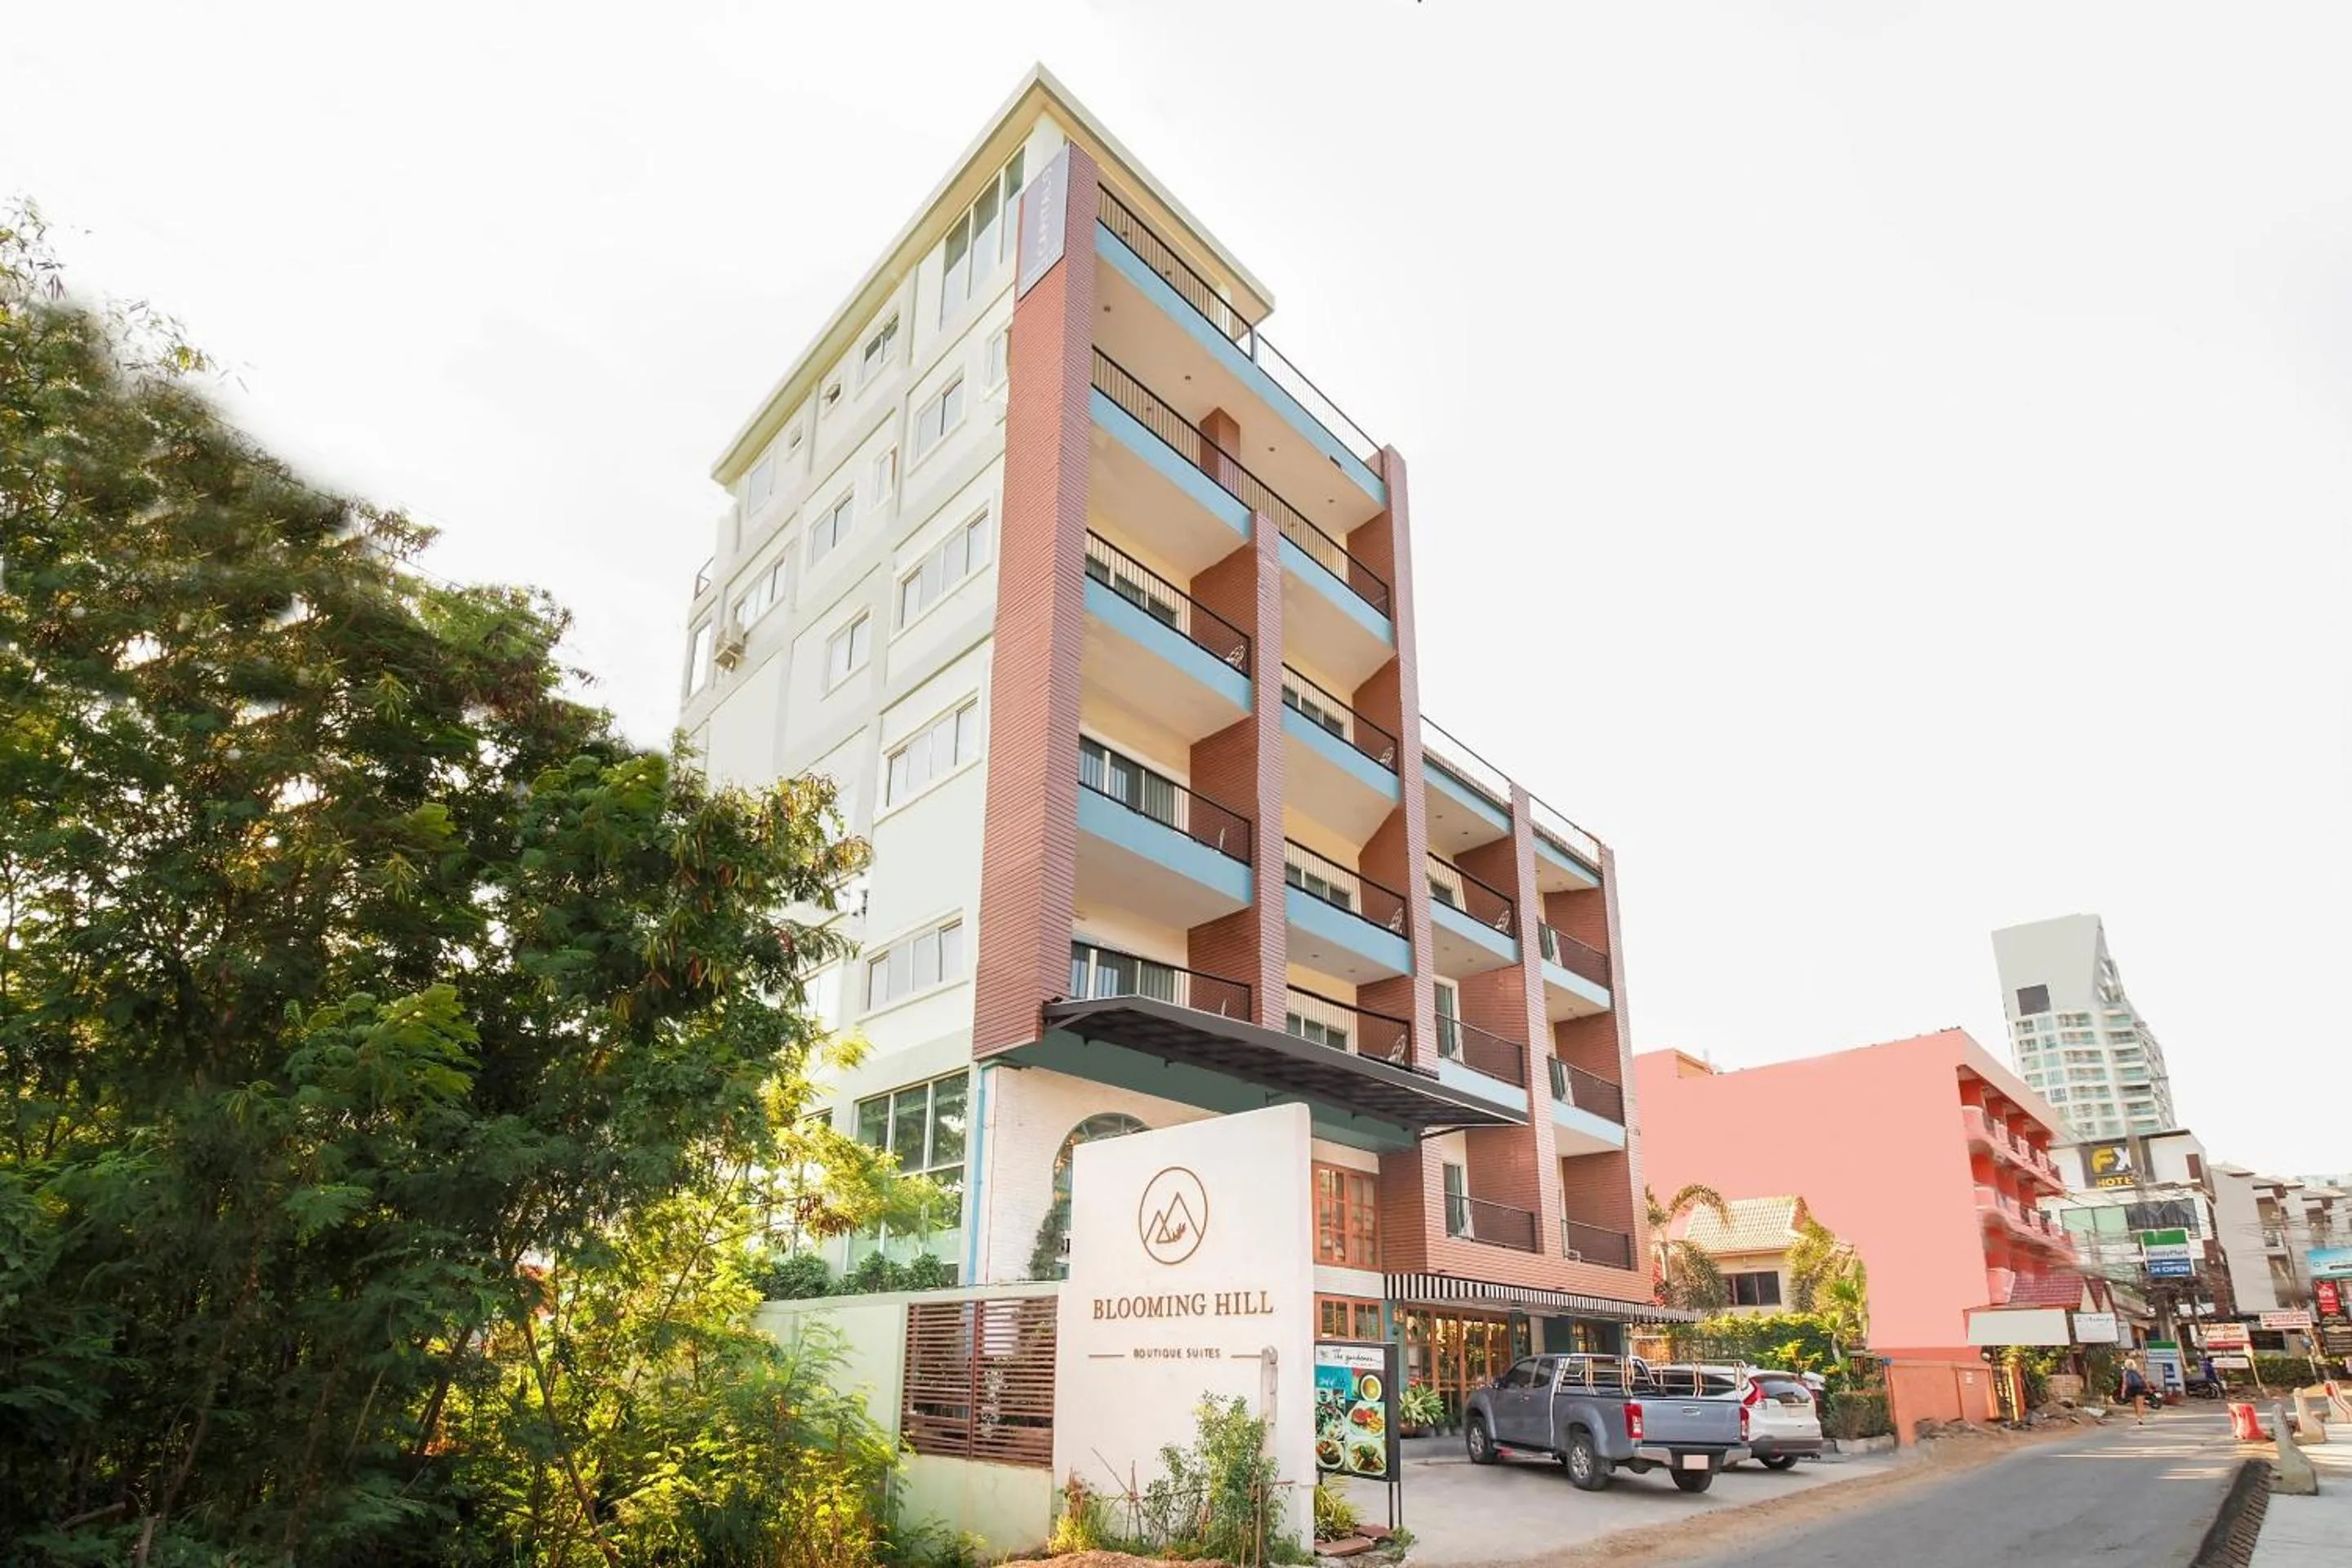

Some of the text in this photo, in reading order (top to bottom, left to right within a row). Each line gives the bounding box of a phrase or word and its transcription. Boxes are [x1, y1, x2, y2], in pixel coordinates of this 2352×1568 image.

[2092, 1147, 2132, 1174] FX
[2096, 1176, 2135, 1187] HOTE
[2162, 1265, 2189, 1273] OPEN
[1092, 1290, 1274, 1320] BLOOMING HILL
[1133, 1348, 1221, 1359] BOUTIQUE SUITES
